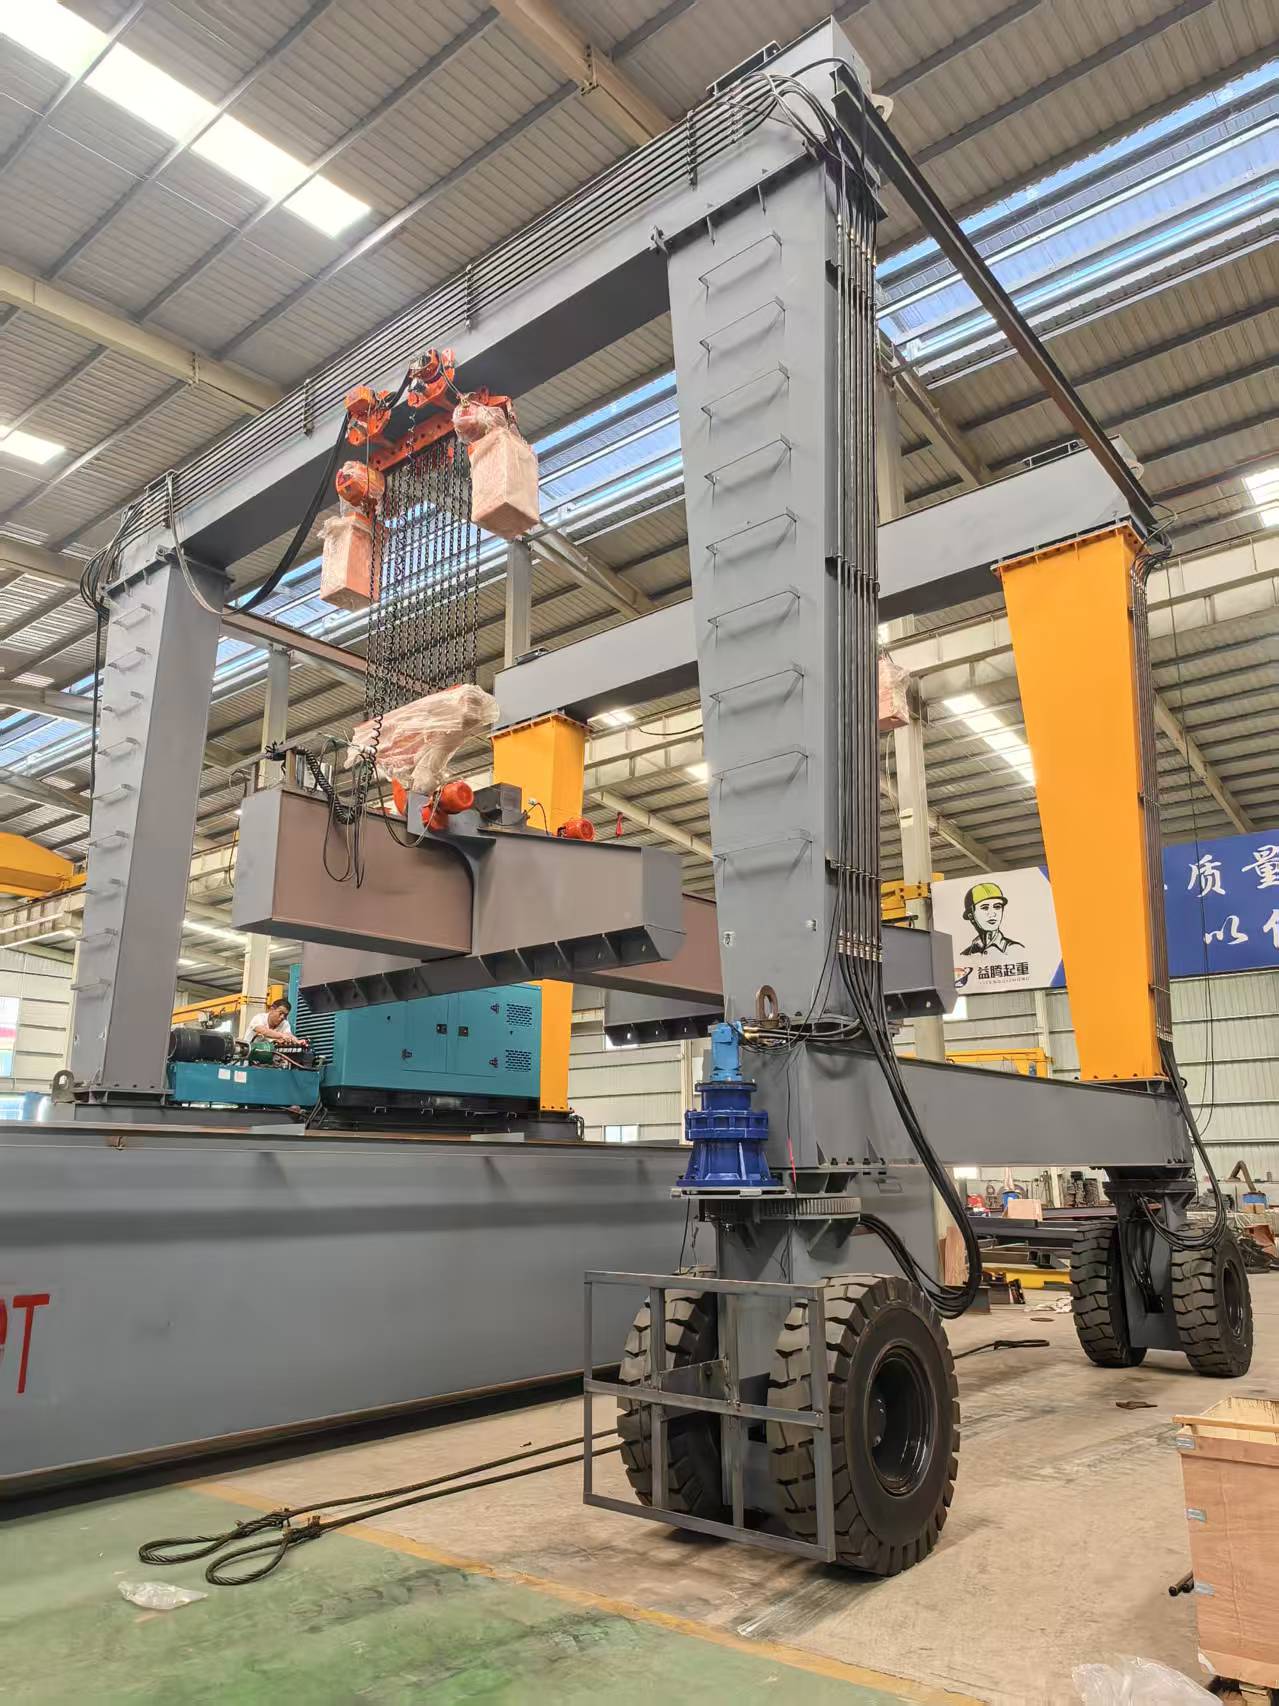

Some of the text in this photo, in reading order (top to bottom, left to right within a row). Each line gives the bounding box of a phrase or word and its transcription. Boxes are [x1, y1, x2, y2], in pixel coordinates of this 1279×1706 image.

[1163, 845, 1279, 897] 质量
[977, 961, 1029, 979] 益腾起重
[0, 1294, 50, 1394] T
